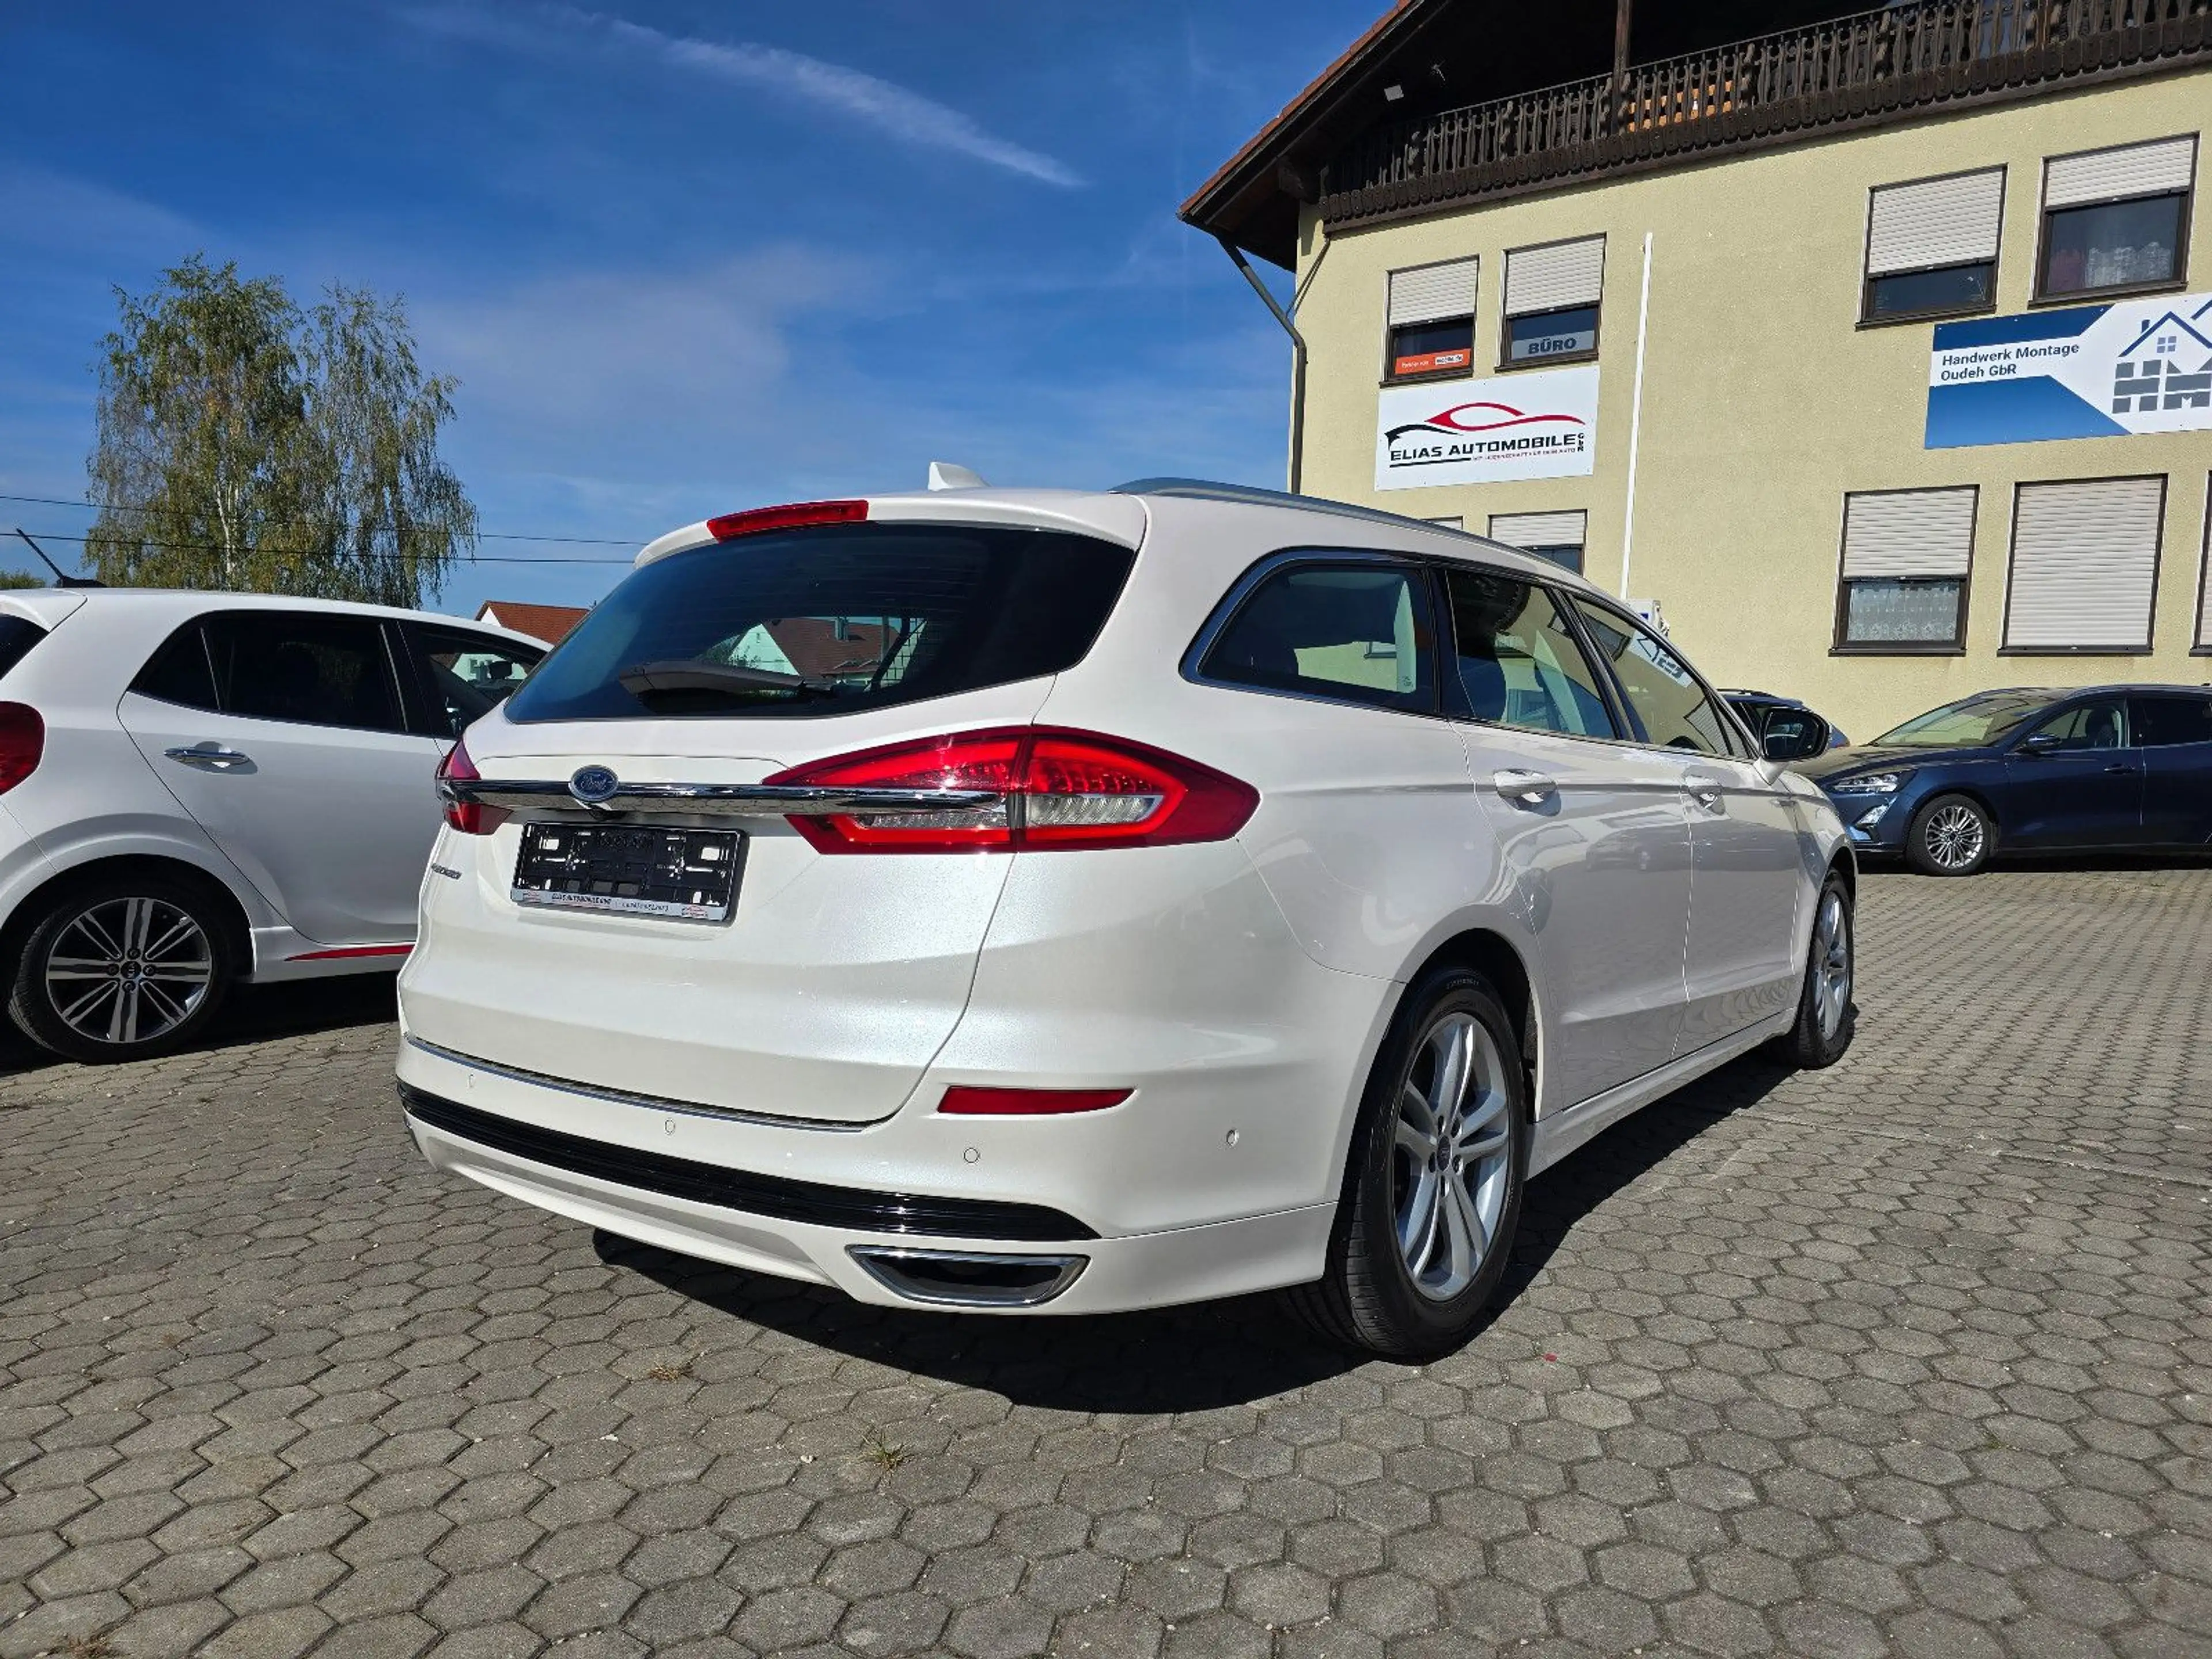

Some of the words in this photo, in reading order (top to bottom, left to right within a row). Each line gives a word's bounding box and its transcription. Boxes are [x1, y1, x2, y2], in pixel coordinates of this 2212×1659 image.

[1528, 338, 1577, 354] BÜRO
[1942, 349, 2012, 366] Handwerk
[2016, 344, 2080, 359] Montage
[1941, 366, 1984, 381] Oudeh
[1988, 363, 2017, 376] GbR
[1390, 446, 1442, 461] ELIAS
[1448, 434, 1577, 455] AUTOMOBILE
